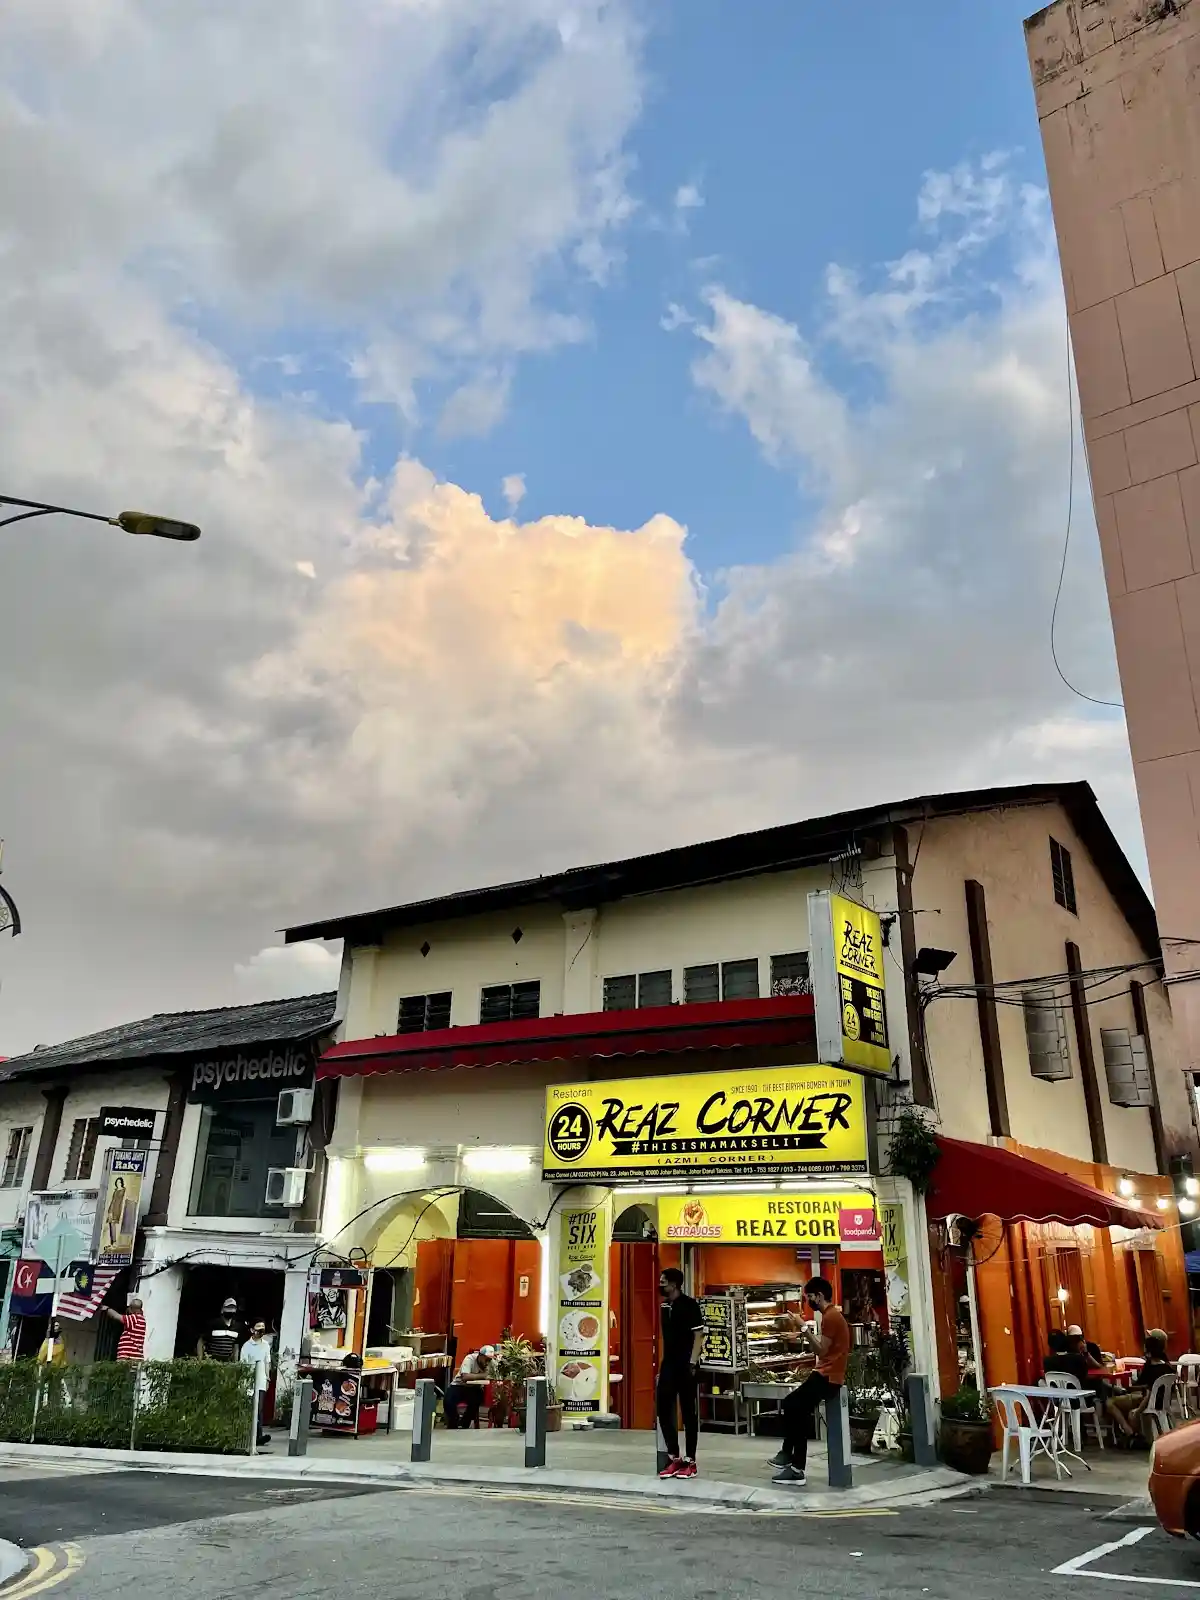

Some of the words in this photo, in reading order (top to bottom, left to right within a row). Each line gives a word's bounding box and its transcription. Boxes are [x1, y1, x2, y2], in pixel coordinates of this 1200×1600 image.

[843, 920, 873, 954] REAZ
[842, 944, 876, 971] CORNER
[846, 1012, 856, 1026] 24
[192, 1046, 306, 1091] psychedelic
[553, 1088, 592, 1099] Restoran
[731, 1085, 744, 1094] SINCE
[745, 1084, 757, 1093] 1990
[763, 1084, 771, 1092] THE
[773, 1083, 784, 1092] BEST
[807, 1080, 828, 1090] BOMBAY
[829, 1080, 834, 1088] IN
[836, 1079, 851, 1088] TOWN
[104, 1117, 153, 1128] psychedelic
[596, 1098, 680, 1141] REAZ
[696, 1091, 852, 1134] CORNER
[558, 1114, 582, 1138] 24
[558, 1142, 581, 1151] HOURS
[631, 1138, 800, 1153] #THISISMAMAKSELIT
[114, 1161, 140, 1171] Raky
[768, 1201, 842, 1214] RESTORAN
[568, 1212, 596, 1225] #TOP
[568, 1224, 596, 1244] SIX
[666, 1226, 722, 1238] EXTRAJOSS
[736, 1219, 787, 1237] REAZ
[795, 1219, 840, 1237] COR
[844, 1228, 876, 1236] foodpanda
